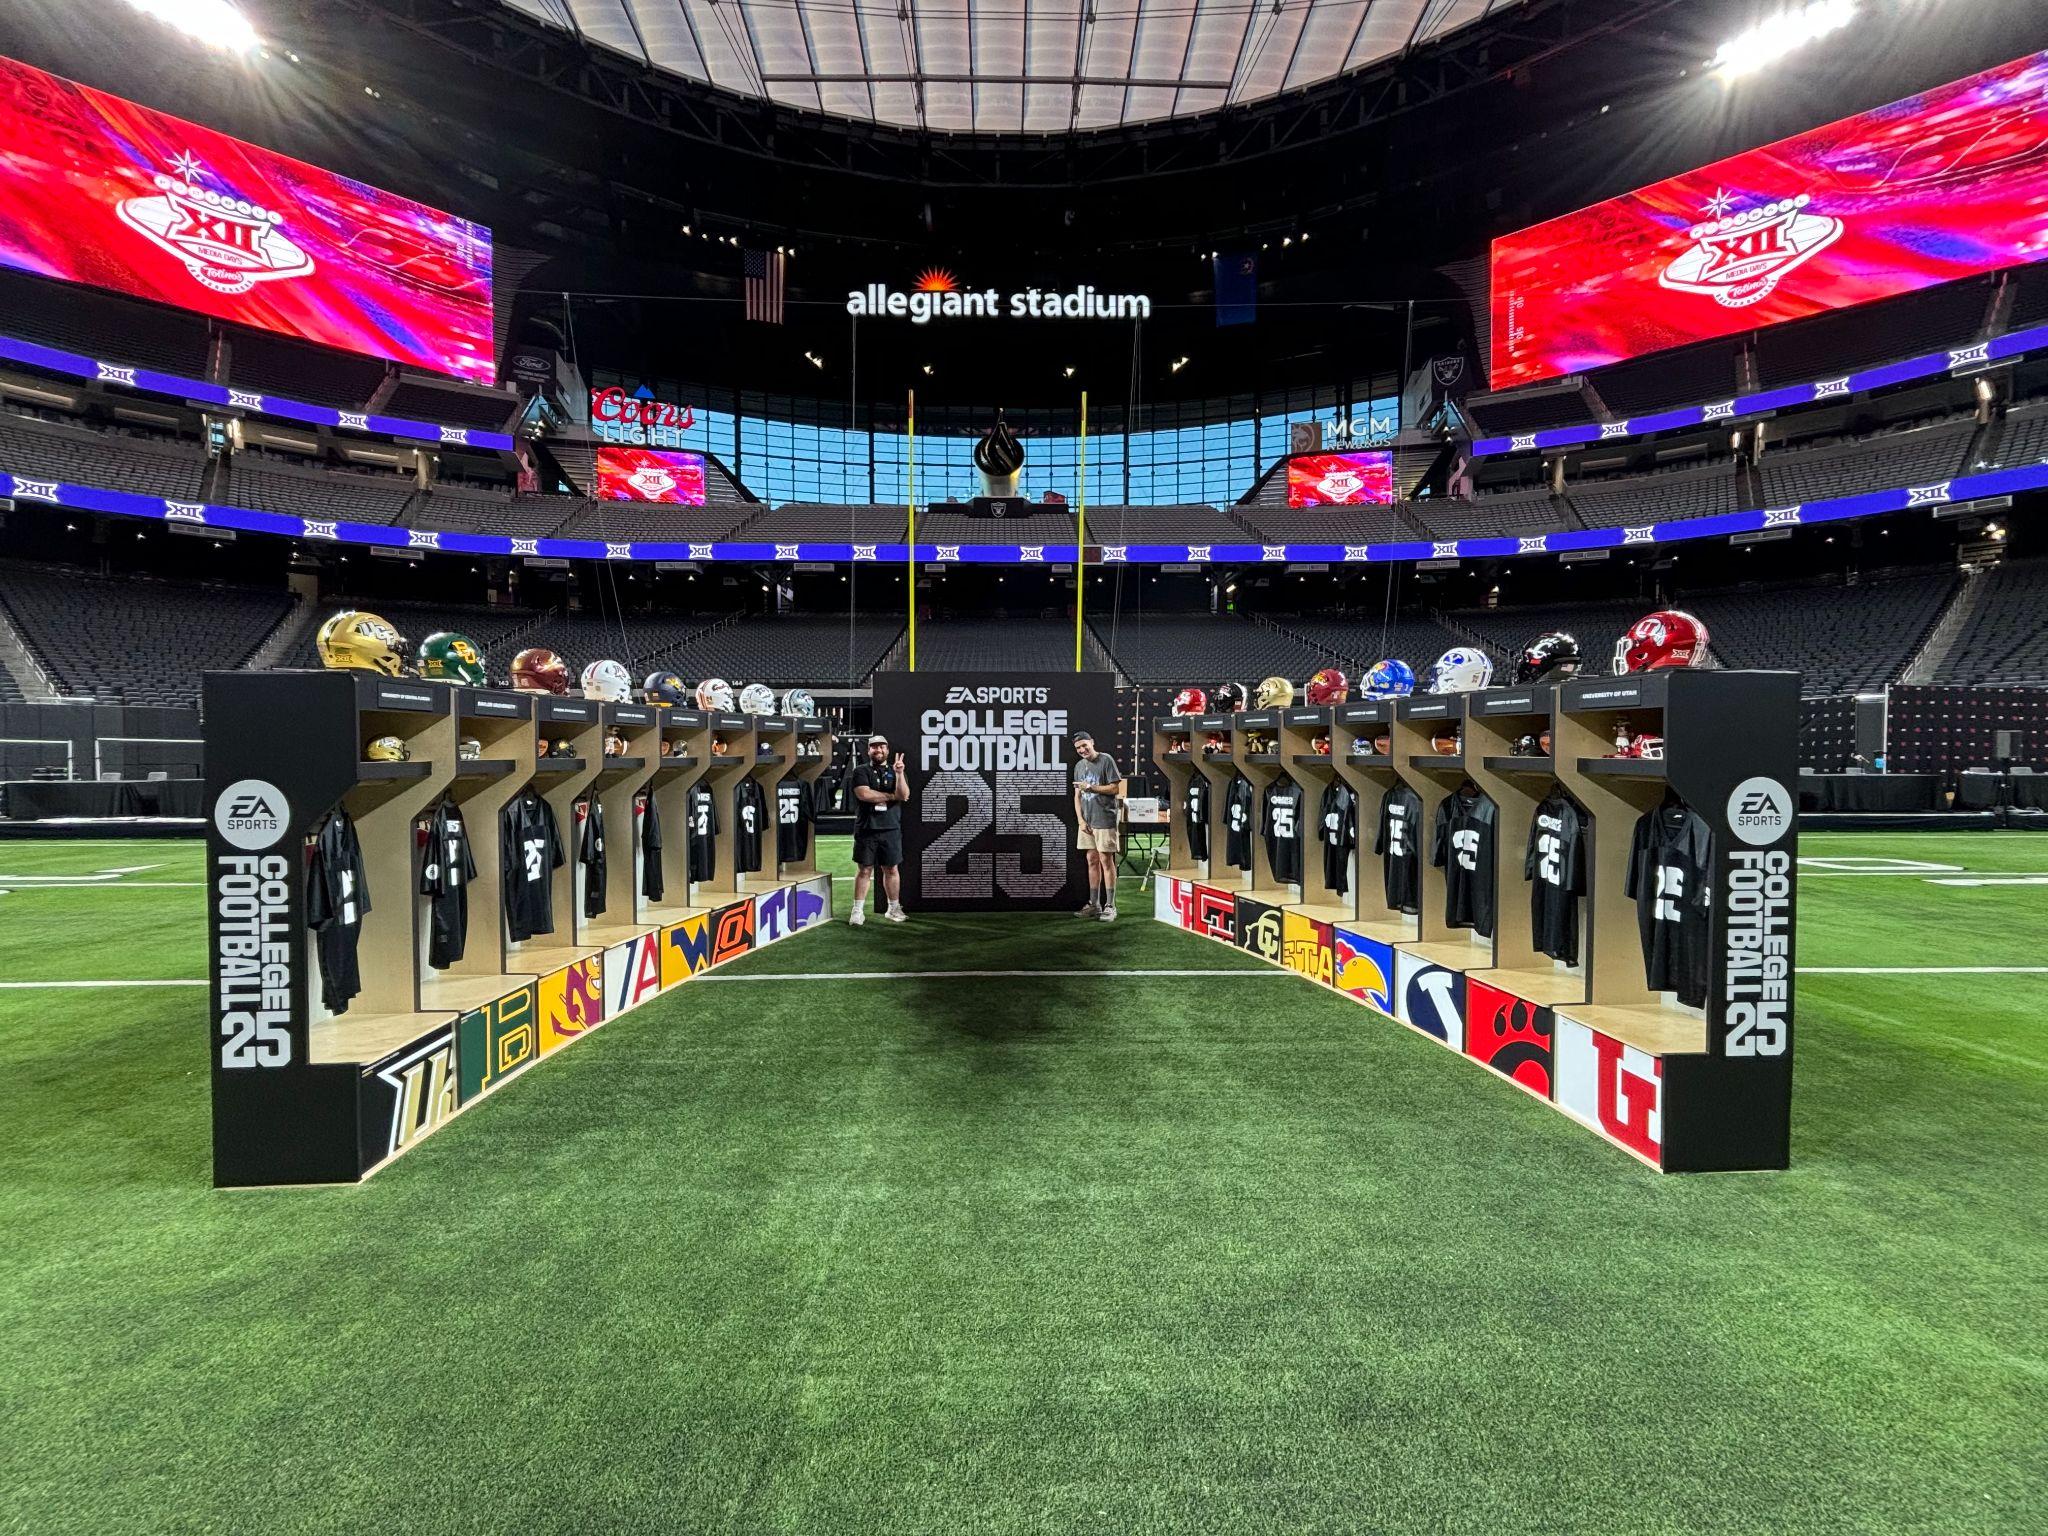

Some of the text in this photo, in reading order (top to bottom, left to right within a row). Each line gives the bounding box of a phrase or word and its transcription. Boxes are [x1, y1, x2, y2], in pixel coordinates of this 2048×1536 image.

[174, 200, 263, 260] XII
[1705, 219, 1790, 275] XII
[847, 283, 1150, 323] allegiant stadium
[591, 385, 697, 430] Coors
[602, 424, 685, 447] LIGHT
[1327, 416, 1391, 438] MGM
[358, 621, 395, 646] UCF
[945, 687, 1048, 704] EA SPORTS
[921, 709, 1068, 735] COLLEGE
[921, 735, 1067, 771] FOOTBALL
[228, 796, 276, 818] EA
[779, 798, 800, 824] 25
[1738, 816, 1782, 826] SPORTS
[1739, 792, 1781, 815] EA
[227, 819, 278, 830] SPORTS
[921, 771, 1067, 898] 25
[1272, 807, 1294, 838] 25
[218, 855, 260, 1011] FOOTBALL
[260, 855, 290, 1010] COLLEGE
[1726, 850, 1764, 1001] FOOTBALL
[1762, 850, 1790, 1001] COLLEGE
[221, 1010, 291, 1069] 25
[1725, 1001, 1787, 1057] 25
